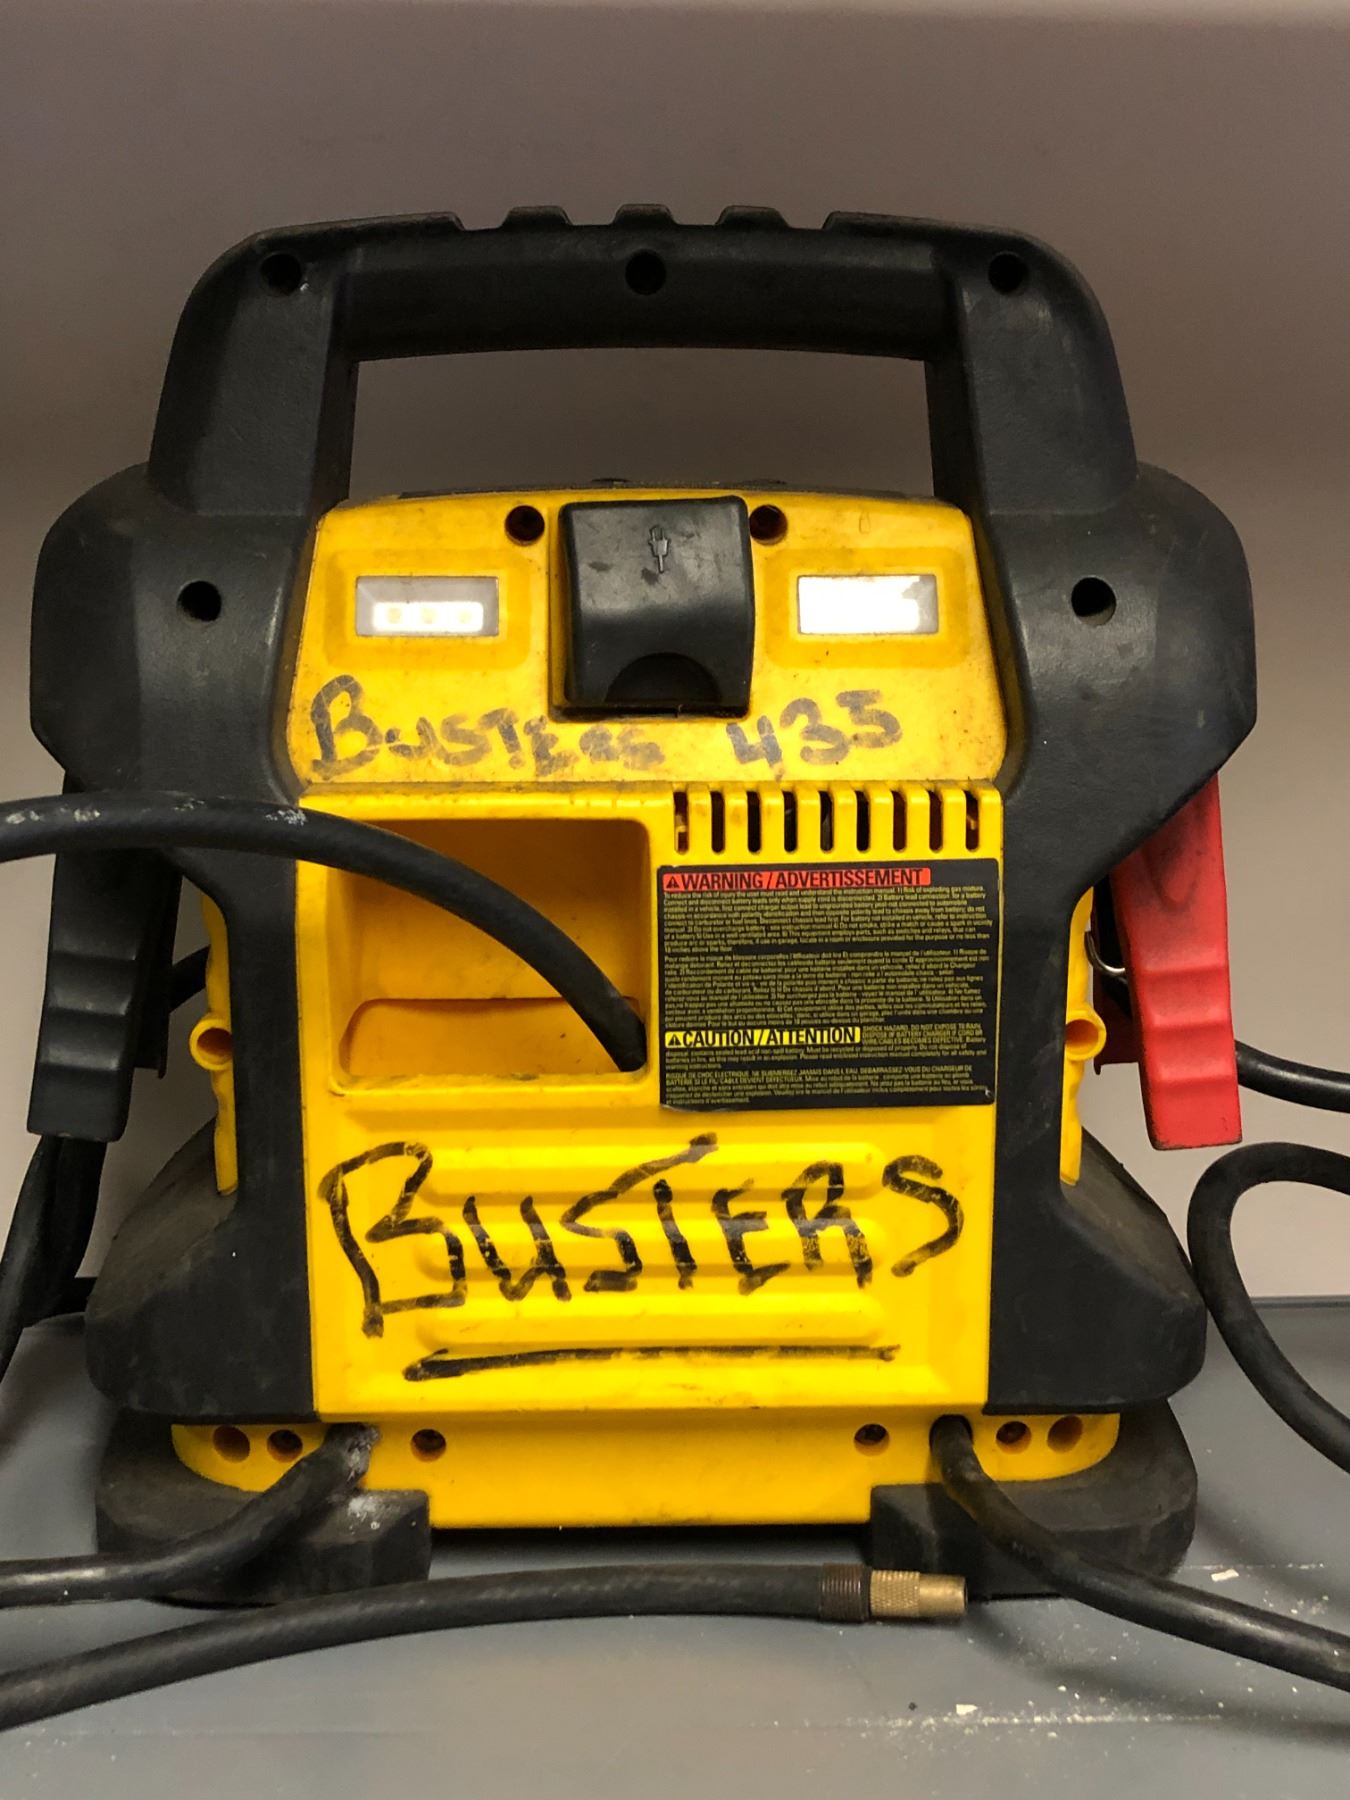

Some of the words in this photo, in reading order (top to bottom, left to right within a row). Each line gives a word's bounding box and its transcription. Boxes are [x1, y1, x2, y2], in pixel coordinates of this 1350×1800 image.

[725, 687, 903, 781] 435
[681, 873, 763, 890] WARNING
[775, 868, 923, 888] ADVERTISSEMENT
[682, 1029, 754, 1047] CAUTION
[767, 1027, 856, 1045] ATTENTION
